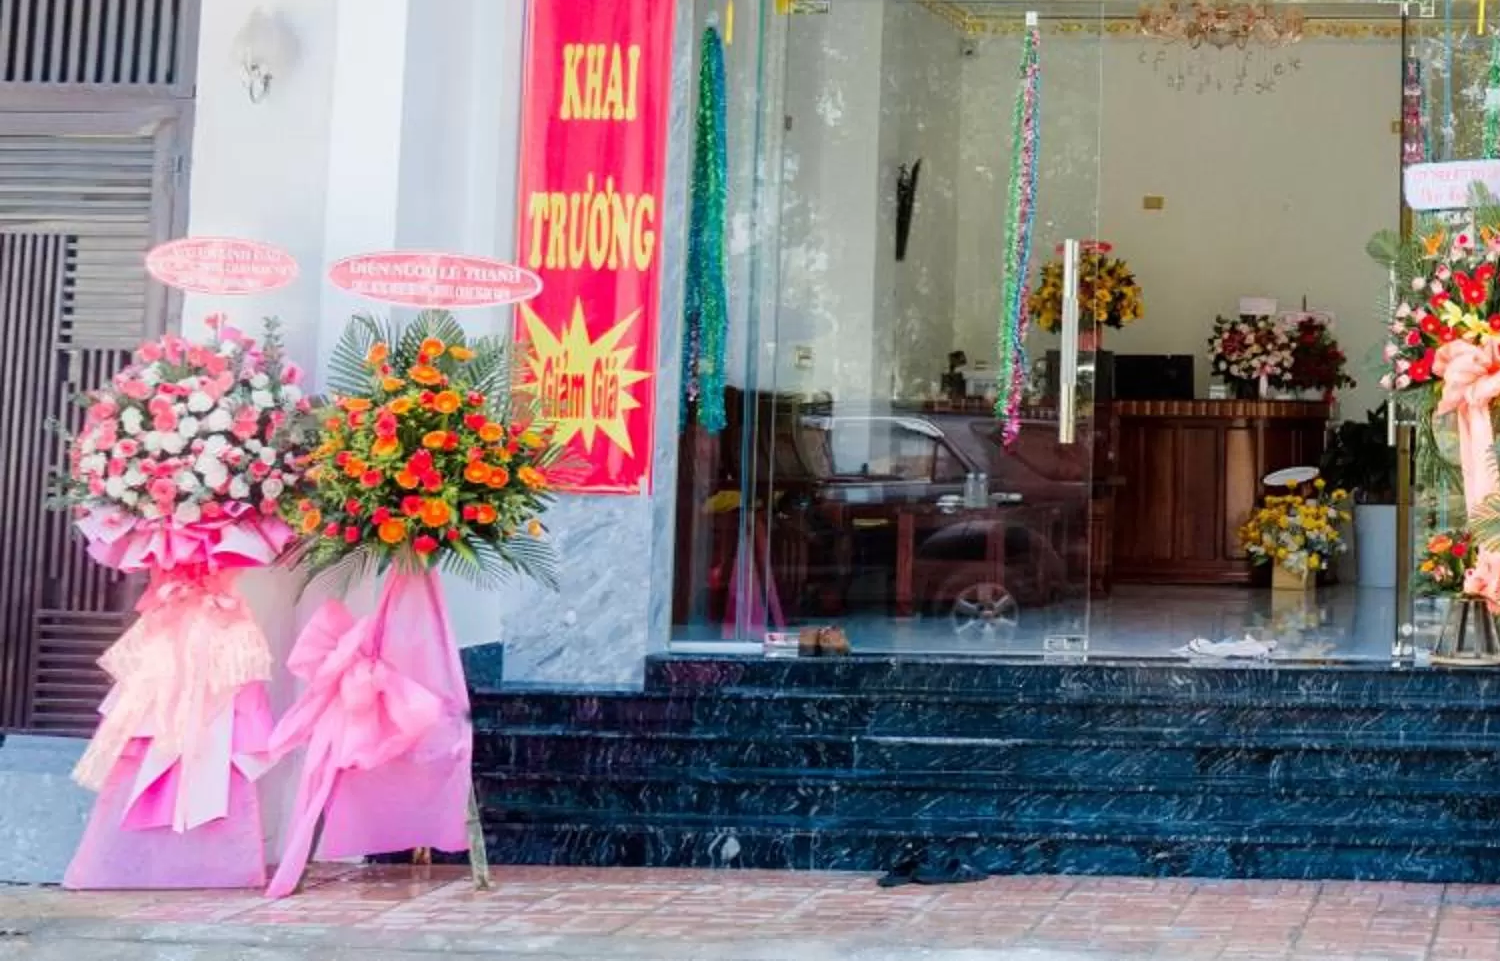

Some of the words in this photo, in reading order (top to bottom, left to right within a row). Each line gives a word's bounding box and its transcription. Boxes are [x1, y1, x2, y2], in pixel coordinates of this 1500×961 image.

[560, 43, 641, 121] KHAI
[528, 171, 655, 271] TRƯƠNG
[541, 348, 585, 419] Giảm
[591, 356, 618, 419] Giá
